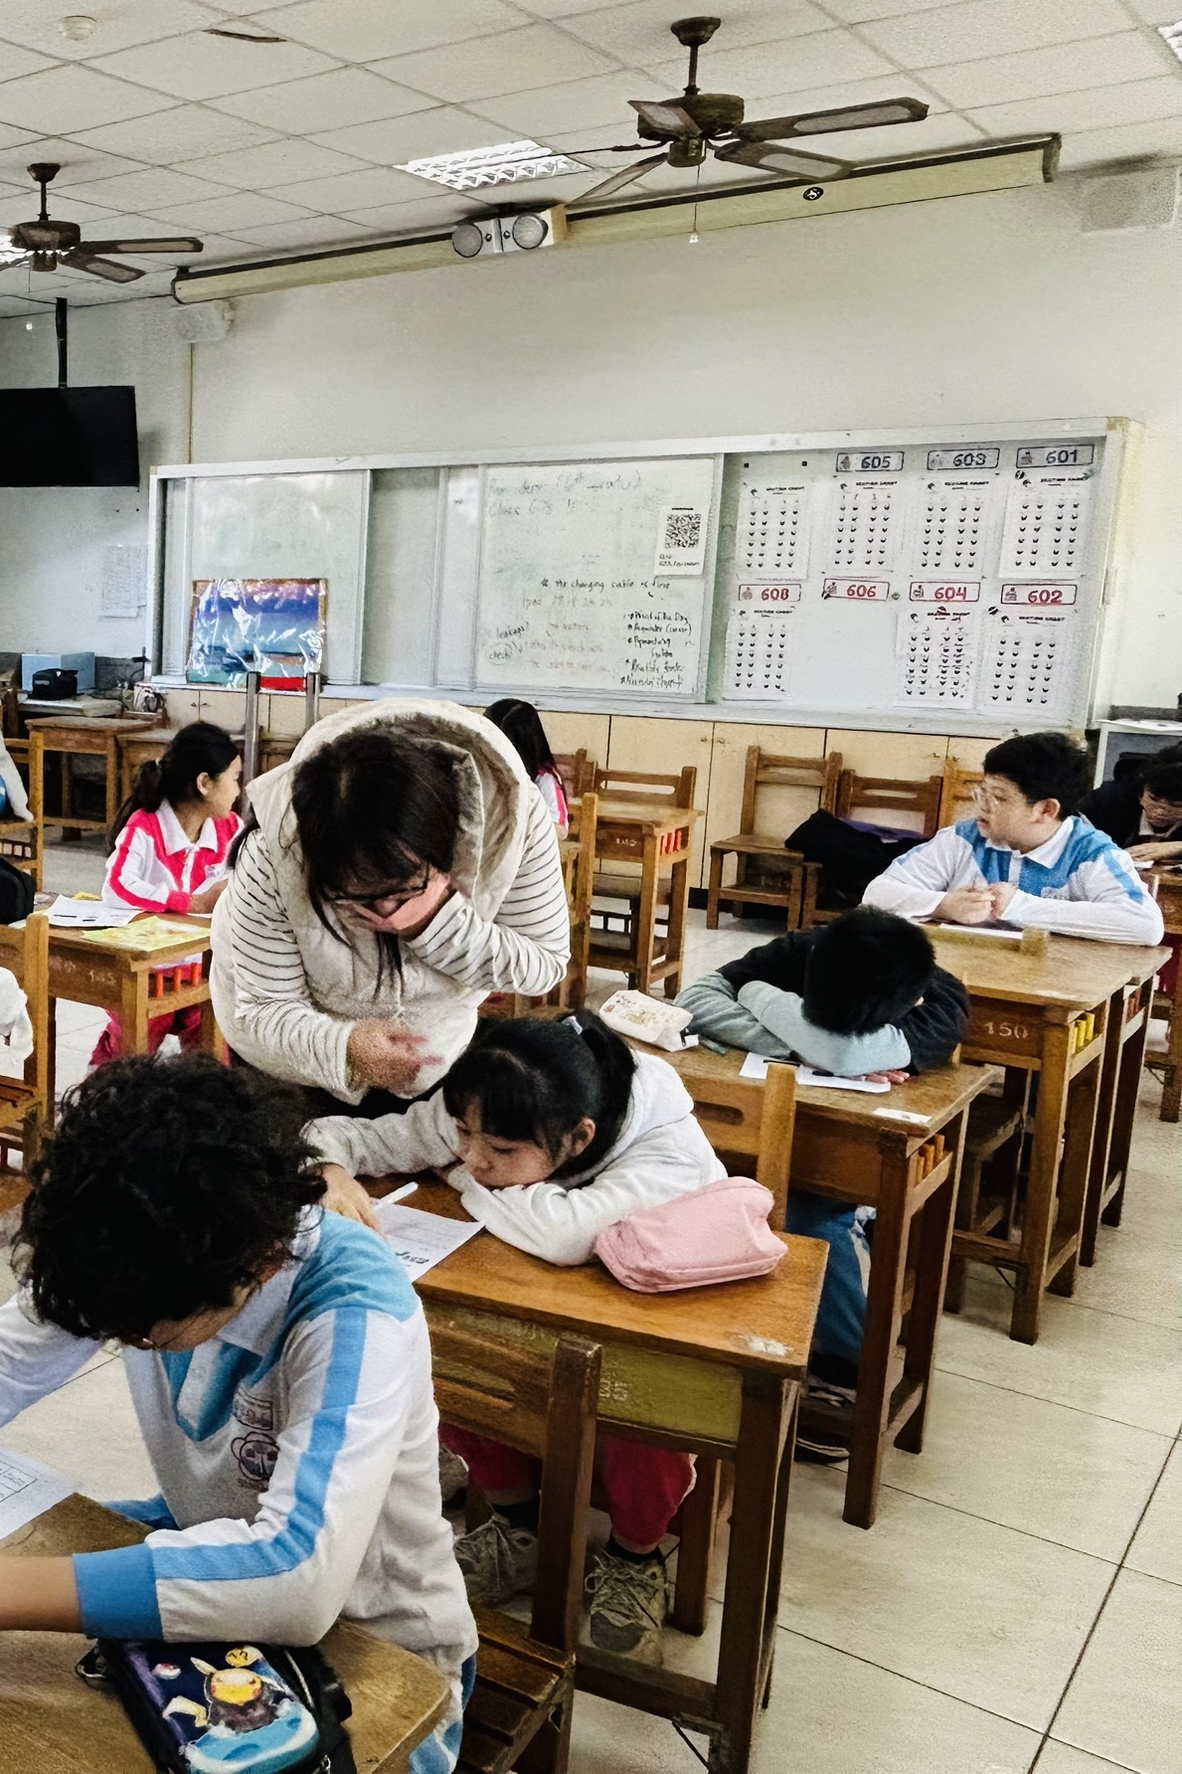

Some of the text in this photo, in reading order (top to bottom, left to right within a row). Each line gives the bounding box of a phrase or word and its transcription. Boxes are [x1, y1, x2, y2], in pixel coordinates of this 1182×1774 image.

[861, 455, 892, 469] 605
[1046, 449, 1078, 464] 601
[846, 584, 877, 598] 606
[934, 586, 967, 601] 604
[1027, 589, 1063, 605] 602
[983, 1021, 1028, 1040] 150
